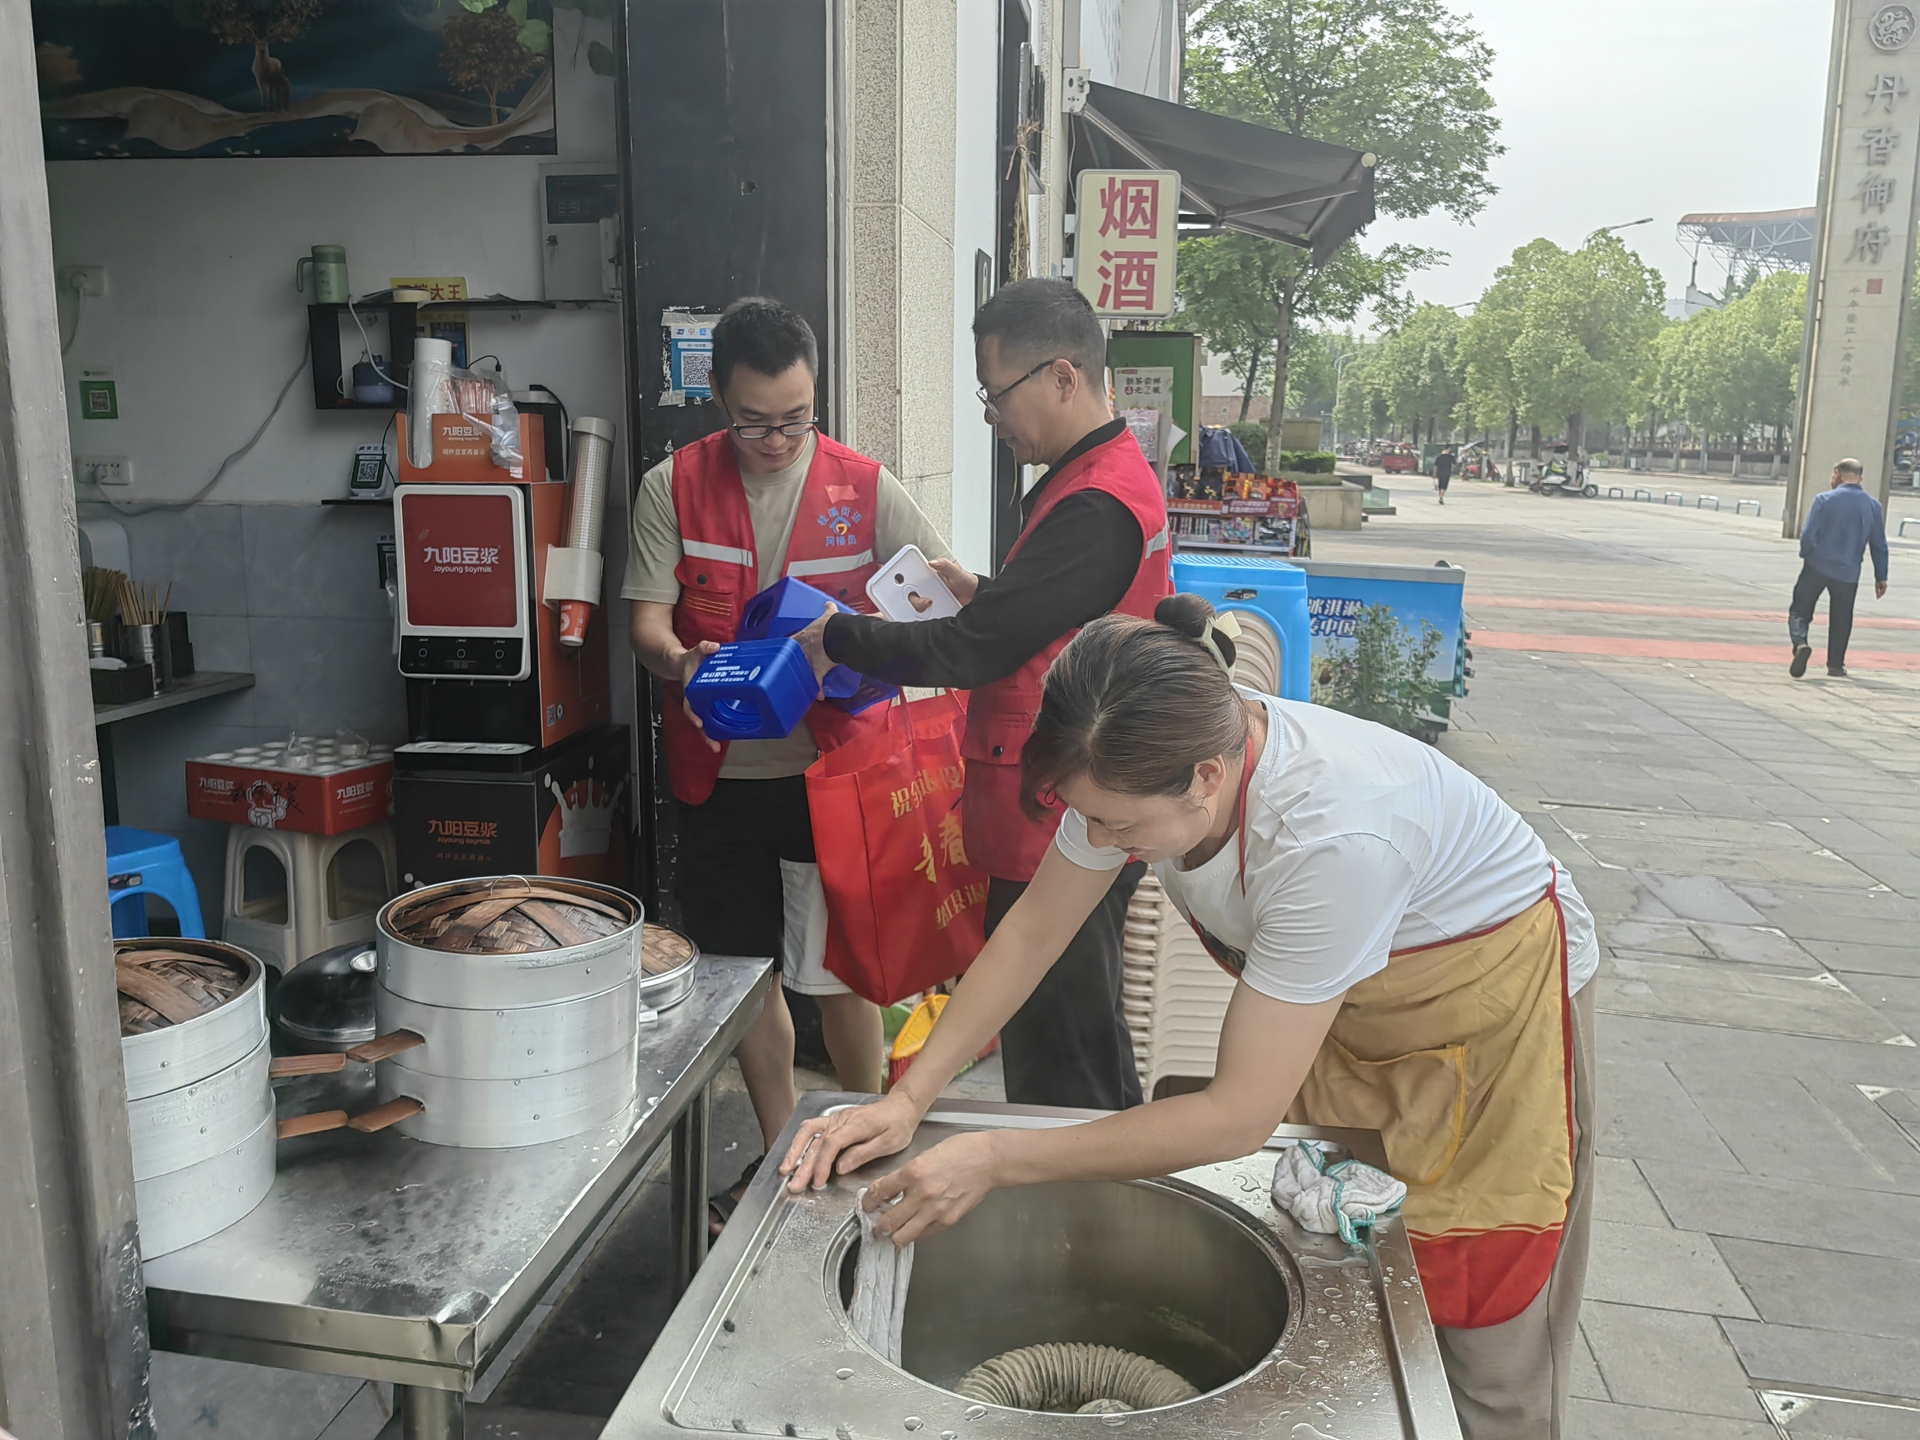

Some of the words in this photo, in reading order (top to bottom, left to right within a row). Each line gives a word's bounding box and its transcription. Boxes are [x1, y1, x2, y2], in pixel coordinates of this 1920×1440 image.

[1845, 72, 1910, 265] 丹香御府
[1097, 177, 1159, 310] 烟酒
[424, 547, 499, 565] 九阳豆浆
[433, 565, 464, 574] Joyoung
[428, 820, 498, 838] 九阳豆浆
